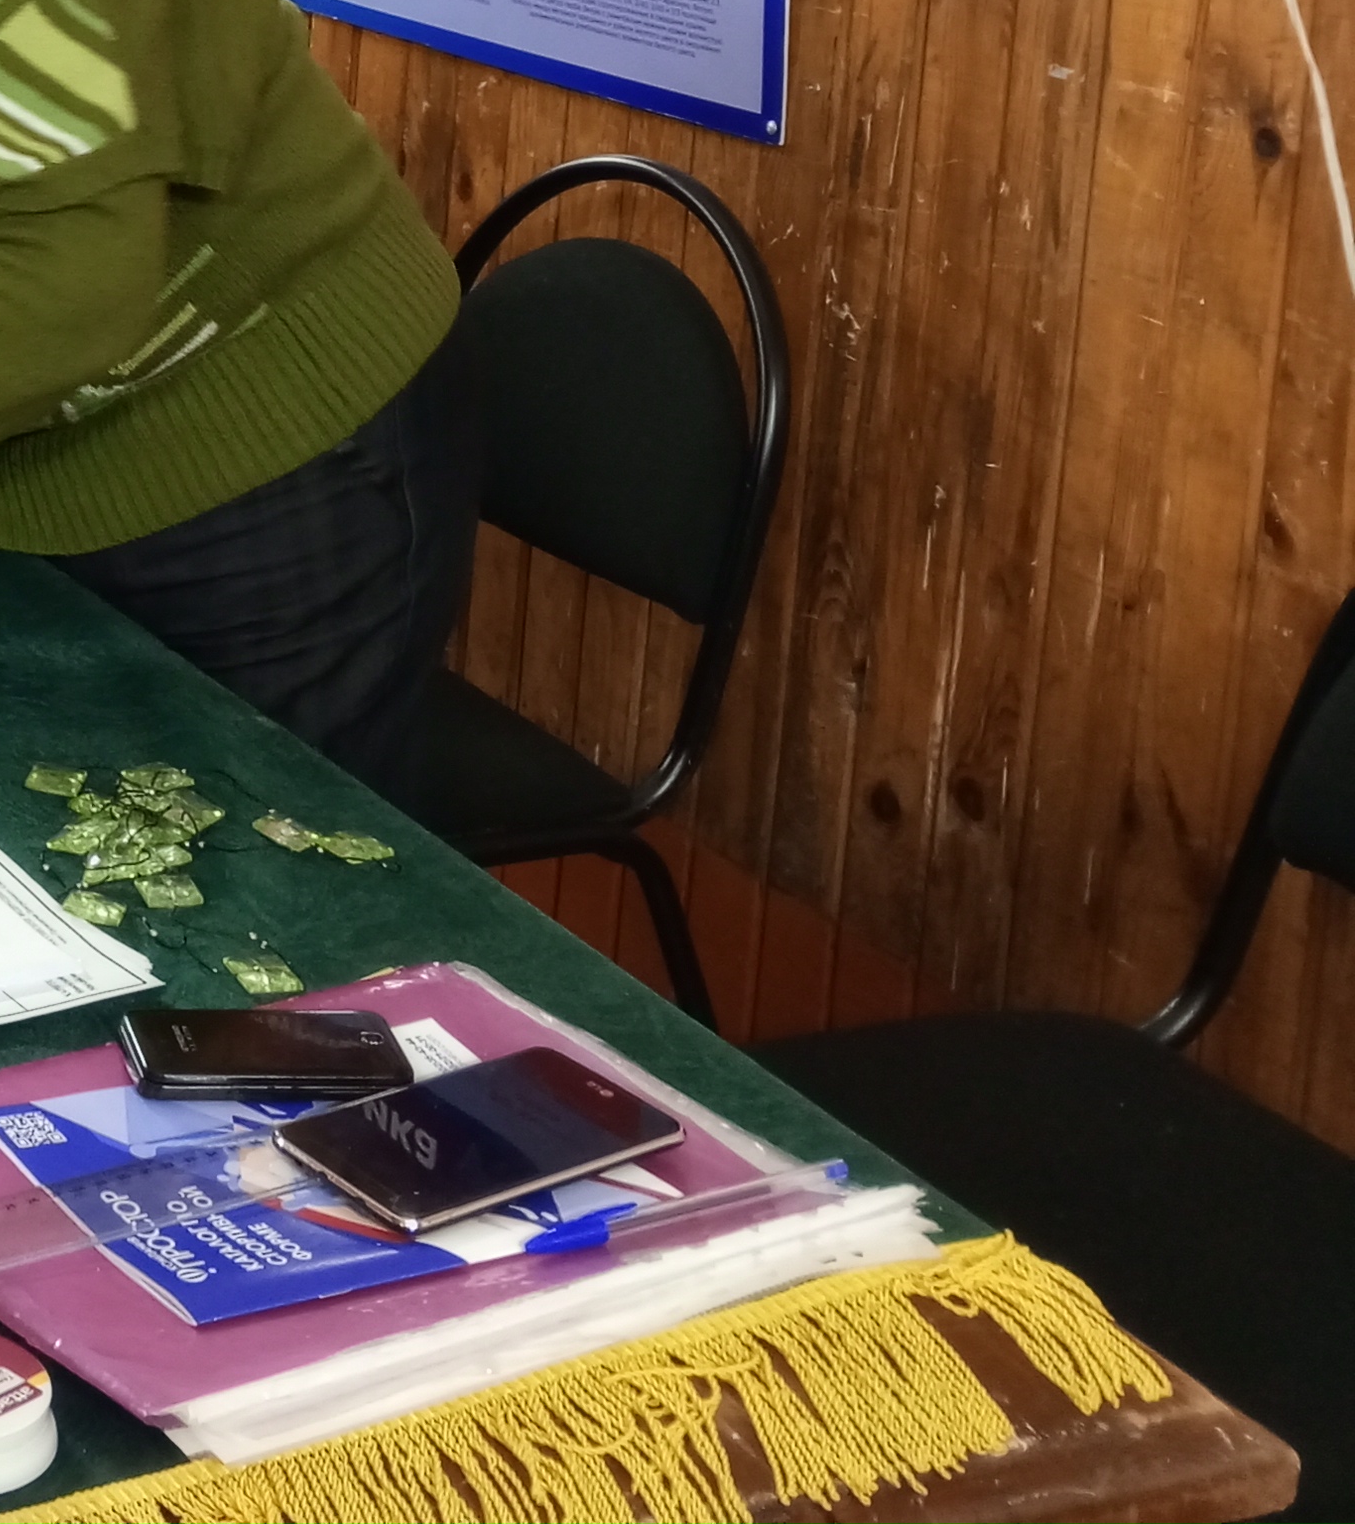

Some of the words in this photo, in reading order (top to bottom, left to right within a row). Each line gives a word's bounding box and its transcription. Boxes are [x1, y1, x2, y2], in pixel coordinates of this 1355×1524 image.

[166, 1200, 198, 1227] ПО
[188, 1227, 264, 1270] КАТАЛОГ
[248, 1222, 311, 1260] ФОРМЕ
